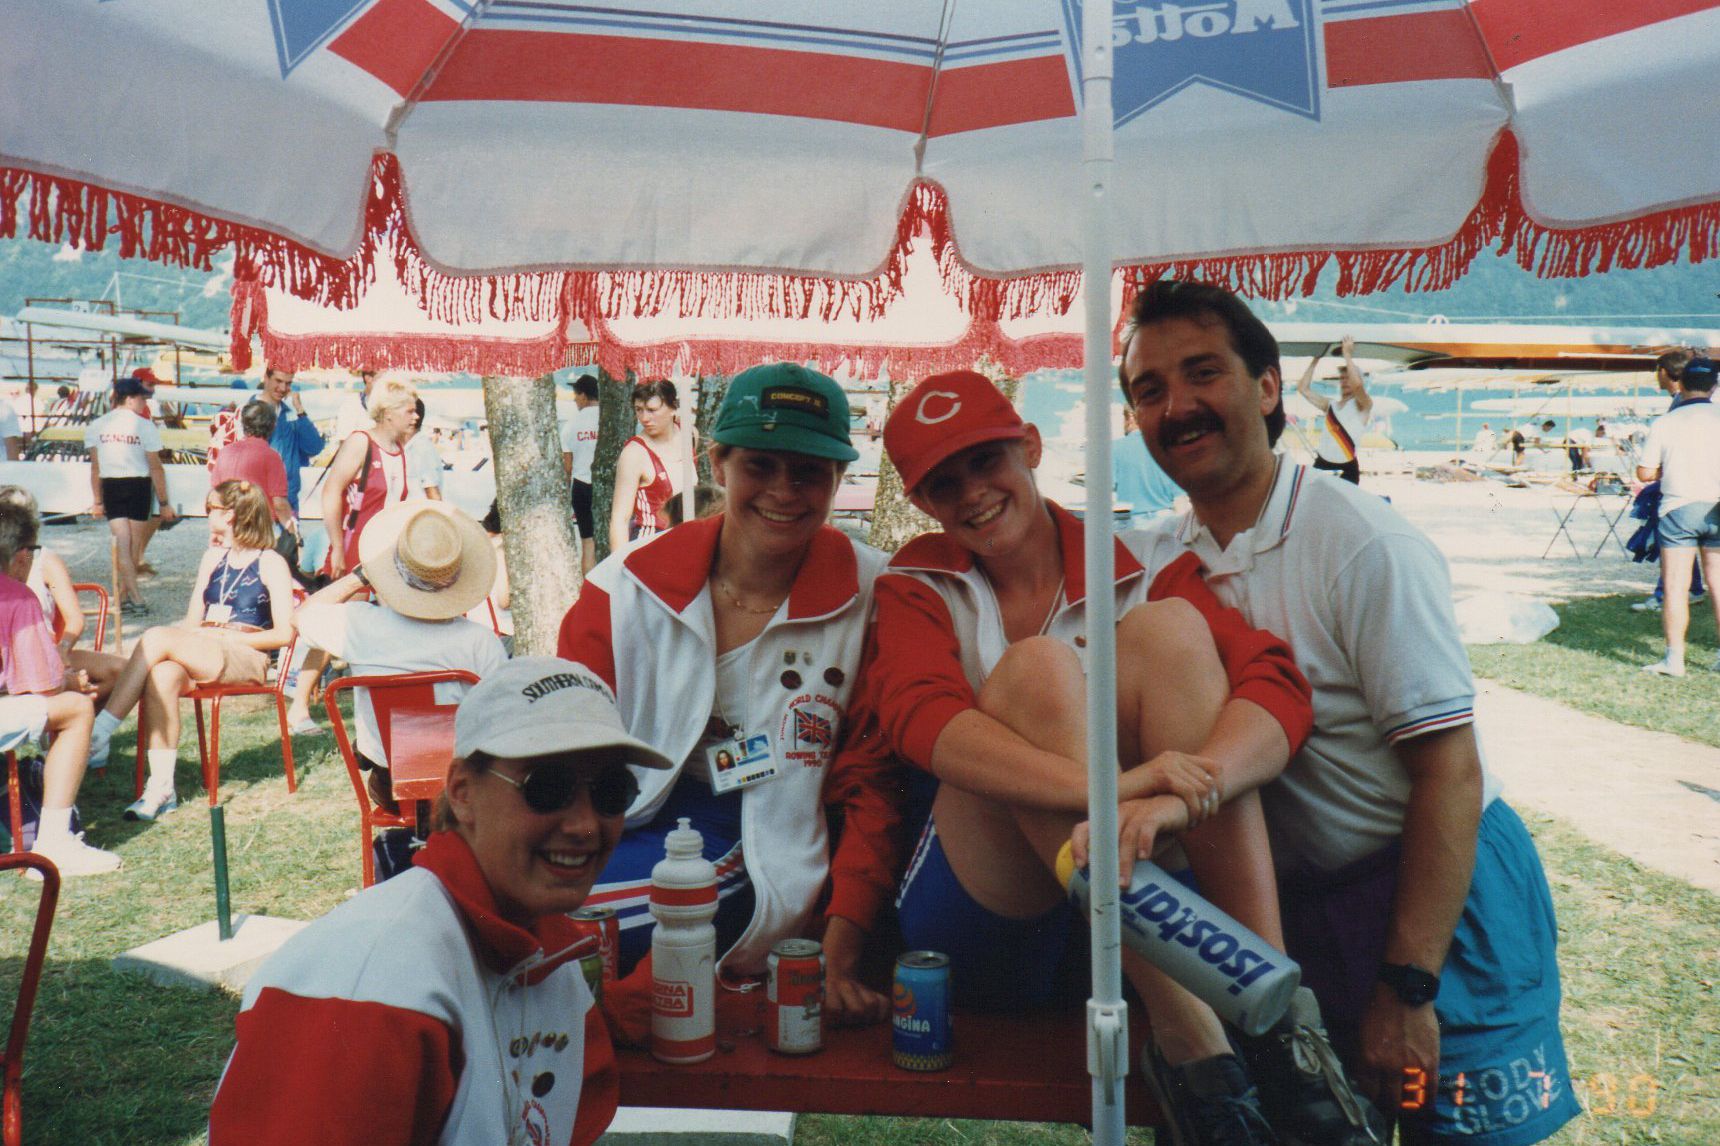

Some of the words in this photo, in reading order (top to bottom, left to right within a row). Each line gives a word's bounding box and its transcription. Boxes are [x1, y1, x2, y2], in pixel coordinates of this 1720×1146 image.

[915, 390, 962, 425] C
[99, 434, 141, 446] CANADA
[576, 430, 600, 441] CAN
[522, 673, 584, 703] SOUTHERN
[785, 751, 816, 760] ROWING
